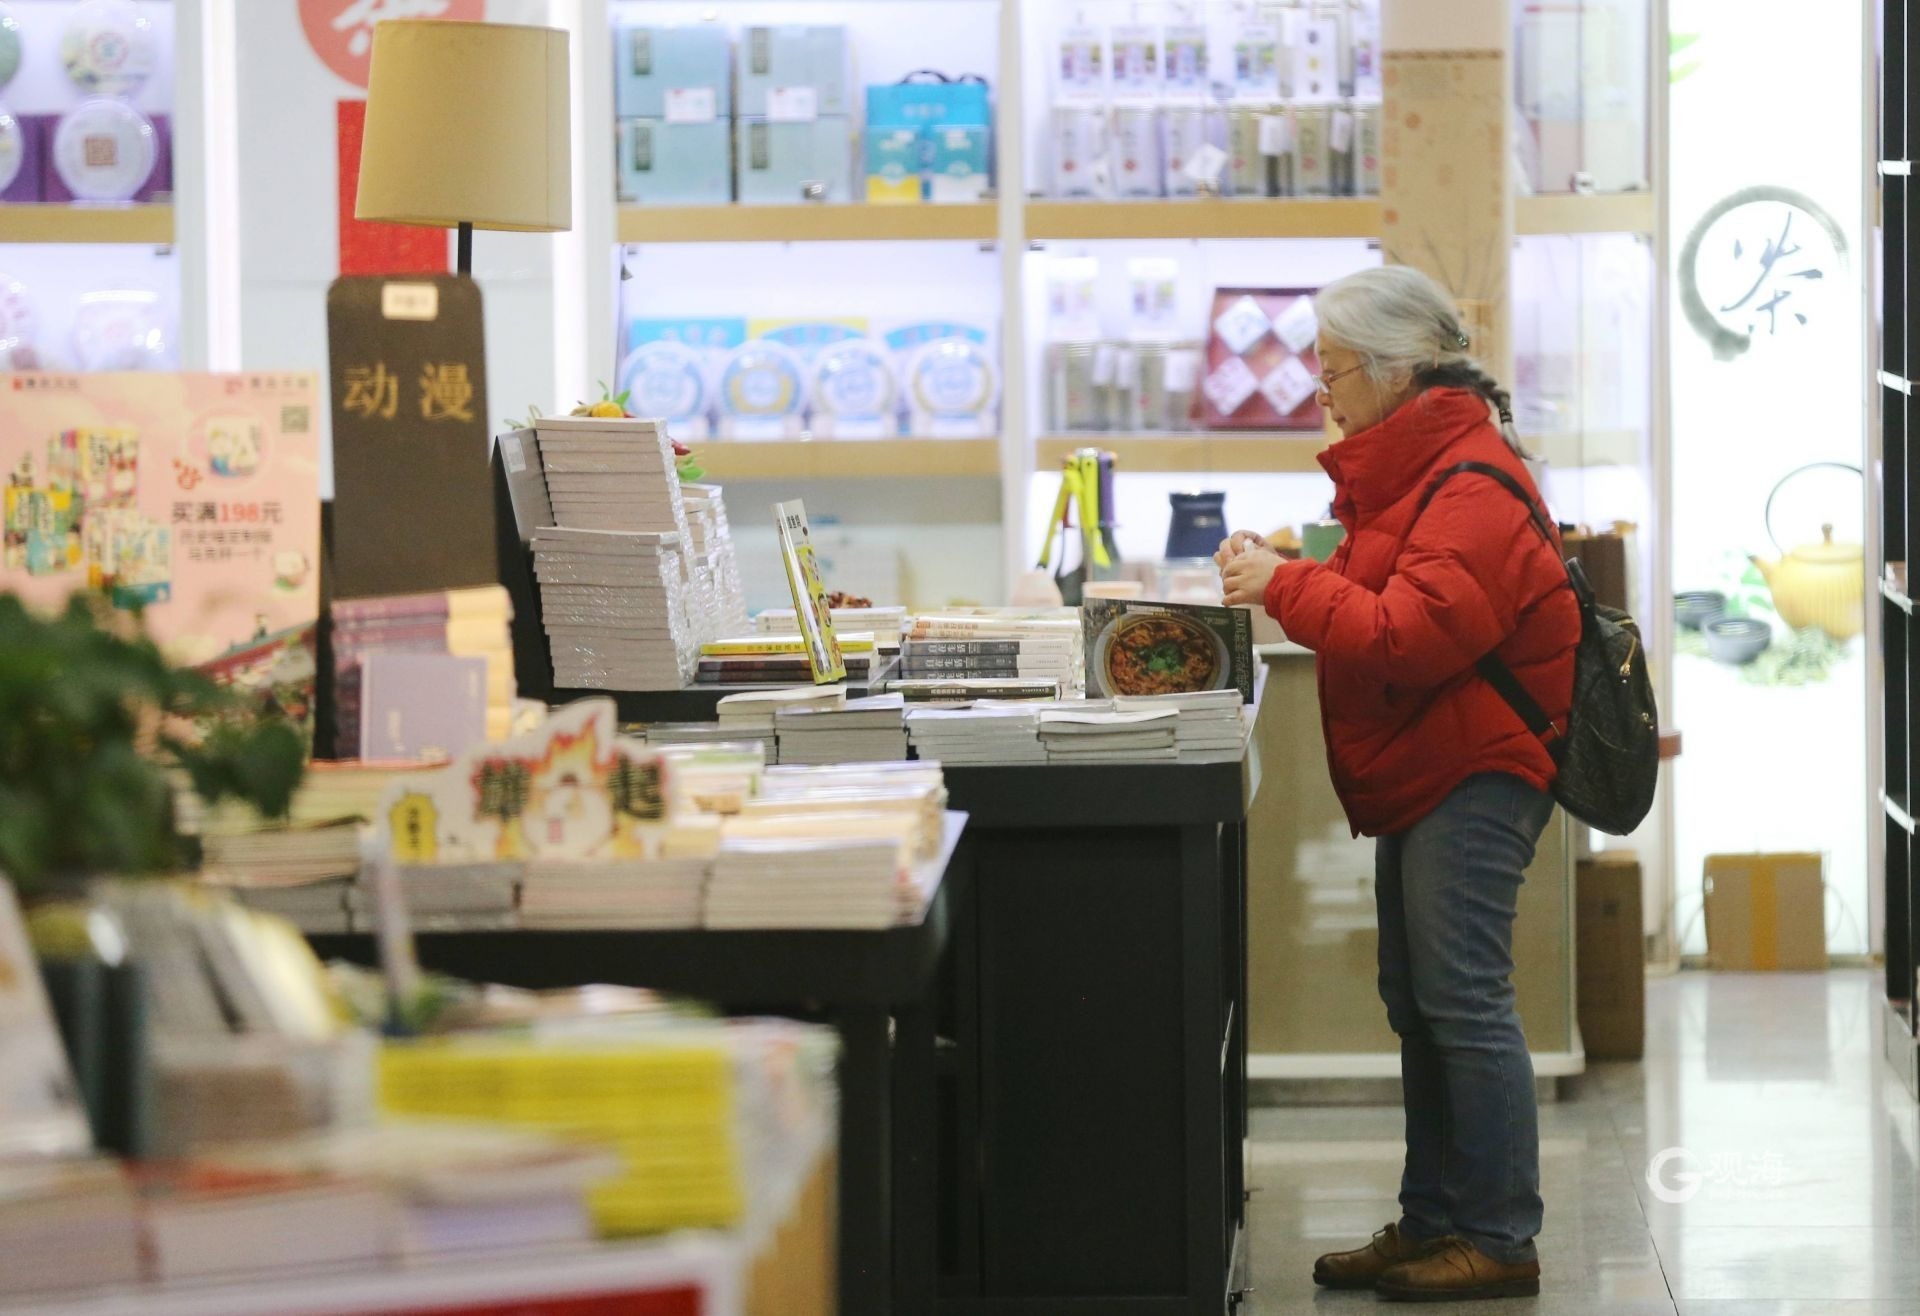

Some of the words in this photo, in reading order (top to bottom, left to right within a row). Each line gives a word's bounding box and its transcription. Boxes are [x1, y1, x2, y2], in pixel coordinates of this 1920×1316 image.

[343, 362, 474, 421] 动漫
[172, 501, 283, 524] 买满198元
